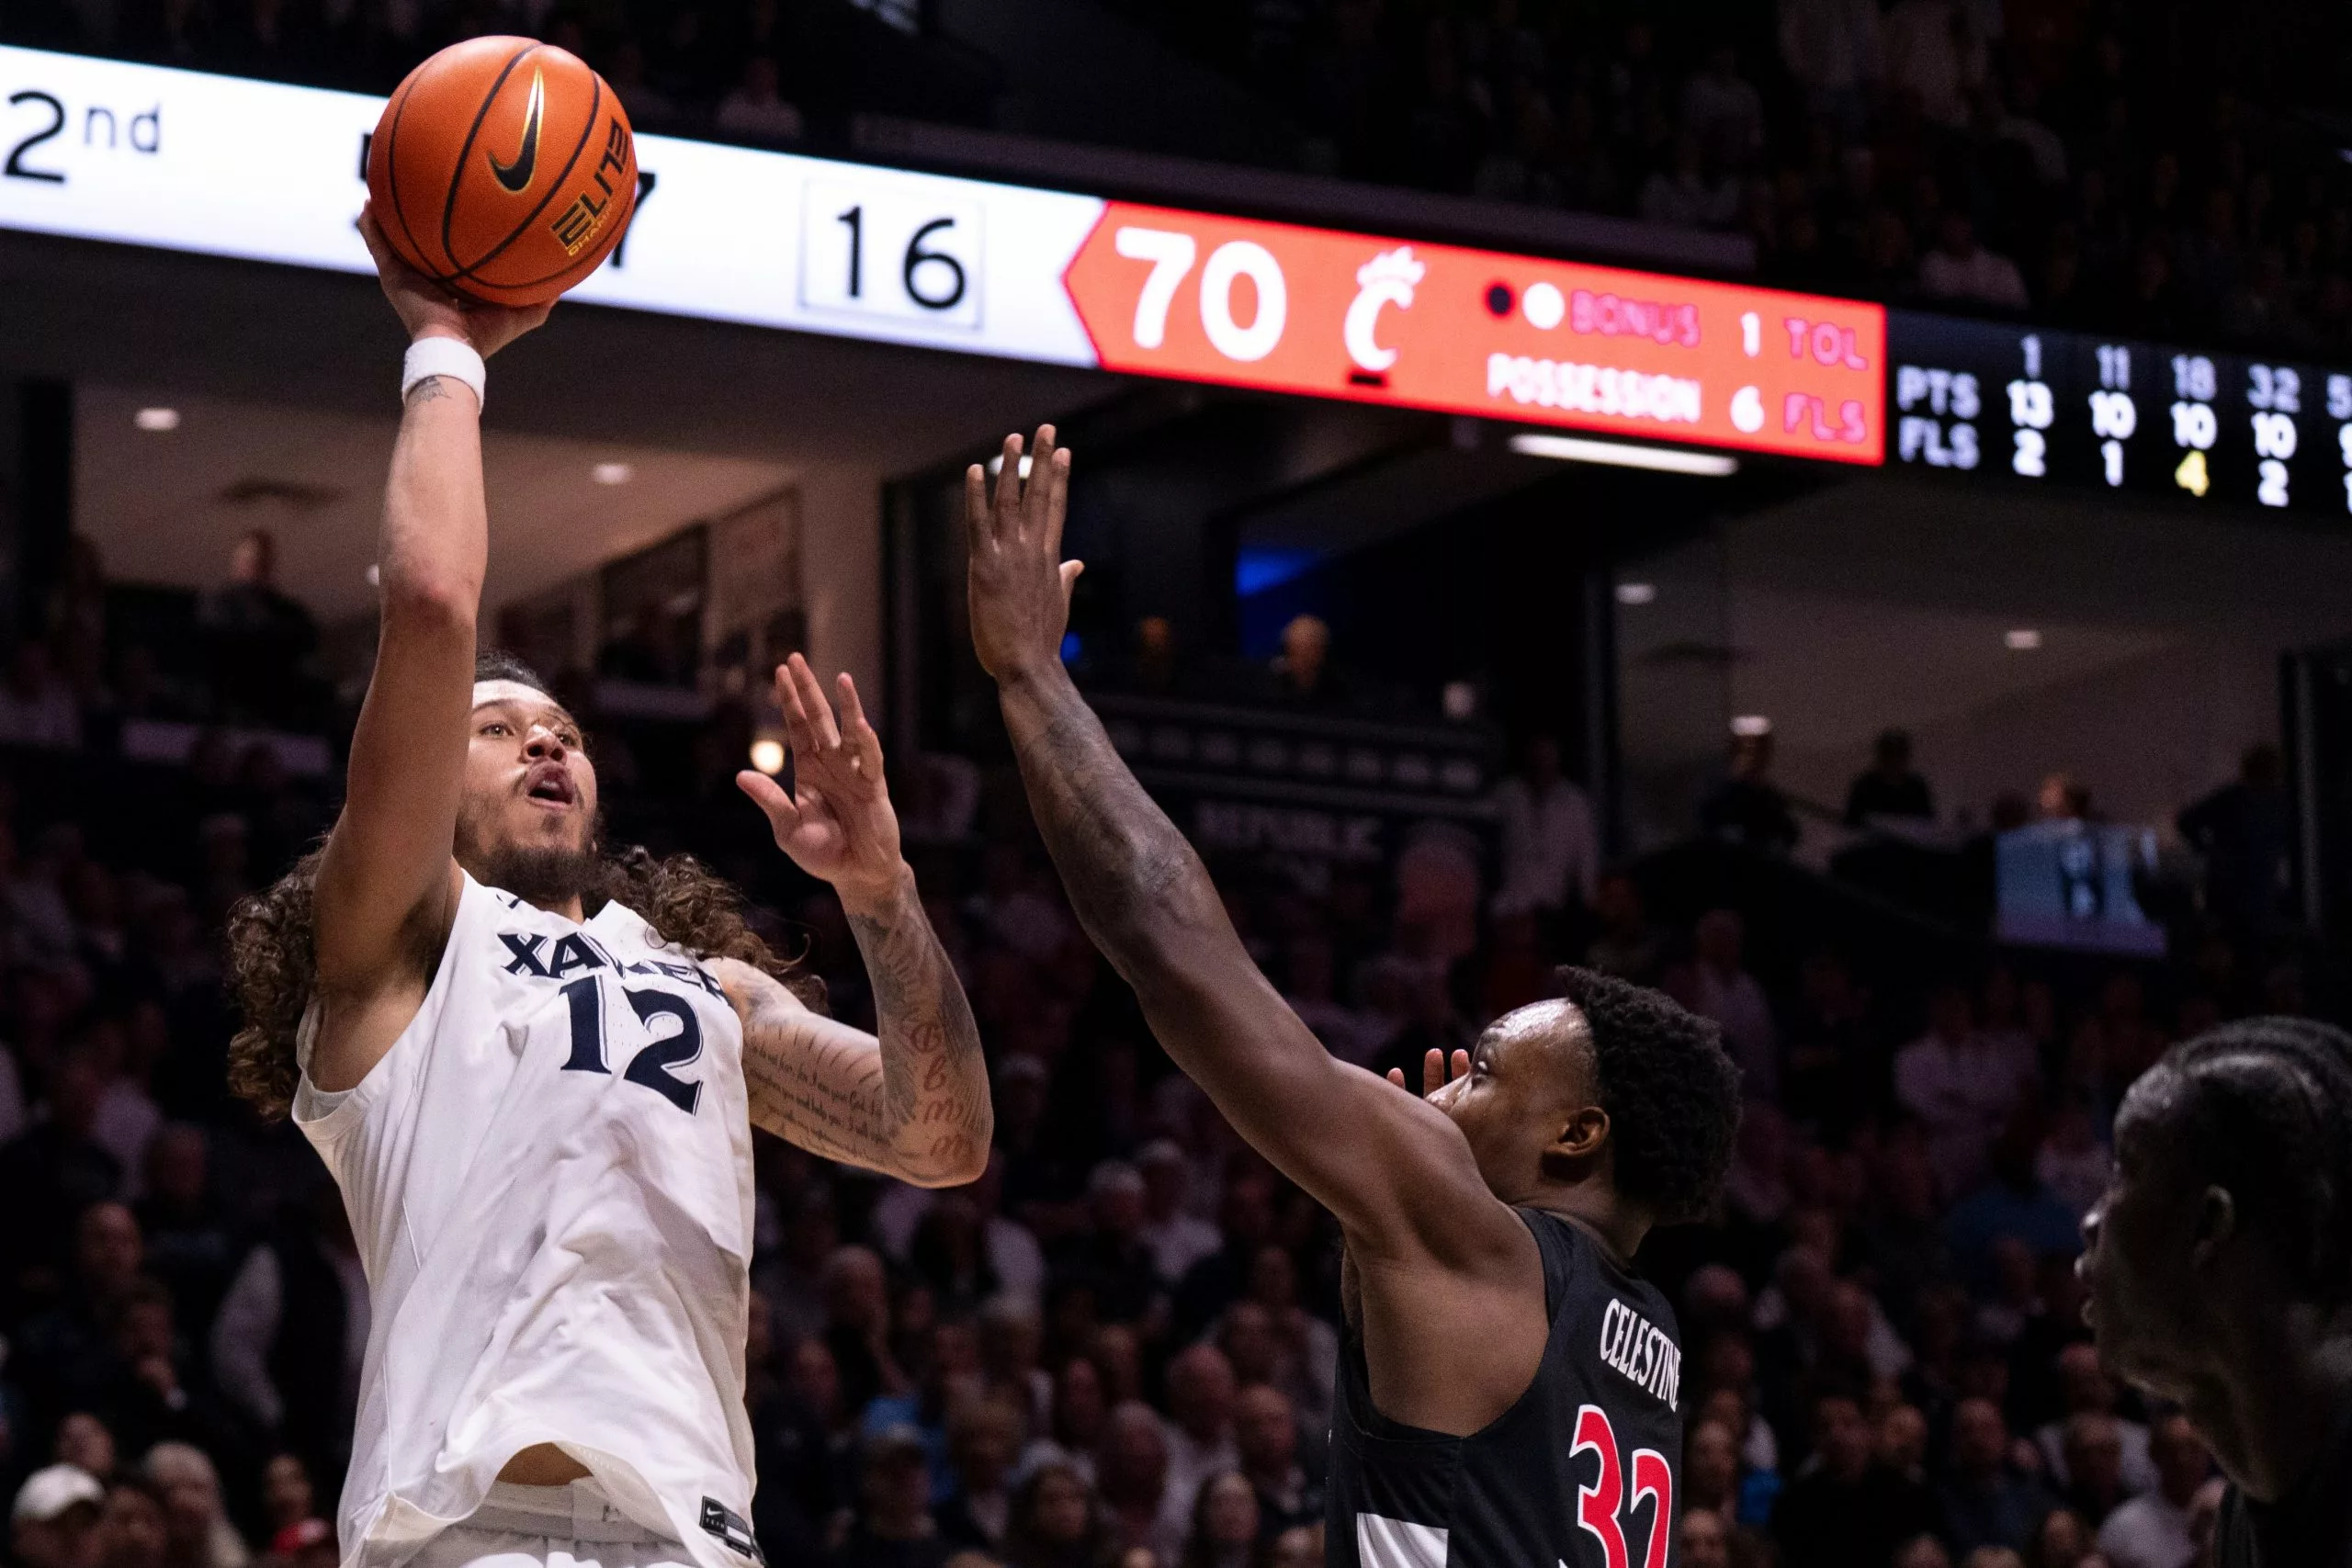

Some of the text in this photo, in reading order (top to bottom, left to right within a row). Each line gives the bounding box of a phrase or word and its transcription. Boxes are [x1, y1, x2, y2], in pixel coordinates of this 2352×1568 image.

[4, 91, 160, 183] 2nd
[551, 117, 628, 248] ELITE
[836, 205, 967, 310] 16
[1115, 226, 1287, 362] 70
[1571, 289, 1701, 347] BONUS
[1740, 311, 1868, 370] 1 TOL
[1487, 353, 1702, 423] POSSESSION
[1730, 385, 1867, 444] 6 FLS
[1896, 366, 1981, 420] PTS
[2089, 389, 2136, 440] 10
[2171, 400, 2217, 450] 10
[2252, 411, 2297, 460] 10
[2022, 333, 2041, 378] 1
[2096, 344, 2131, 391] 11
[2248, 364, 2301, 413] 32
[1898, 416, 1979, 470] FLS
[2013, 428, 2046, 478] 2
[2101, 440, 2123, 488] 1
[2175, 450, 2210, 497] 4
[2258, 459, 2289, 507] 2
[559, 975, 705, 1116] 12
[1600, 1298, 1681, 1413] CELESTINE
